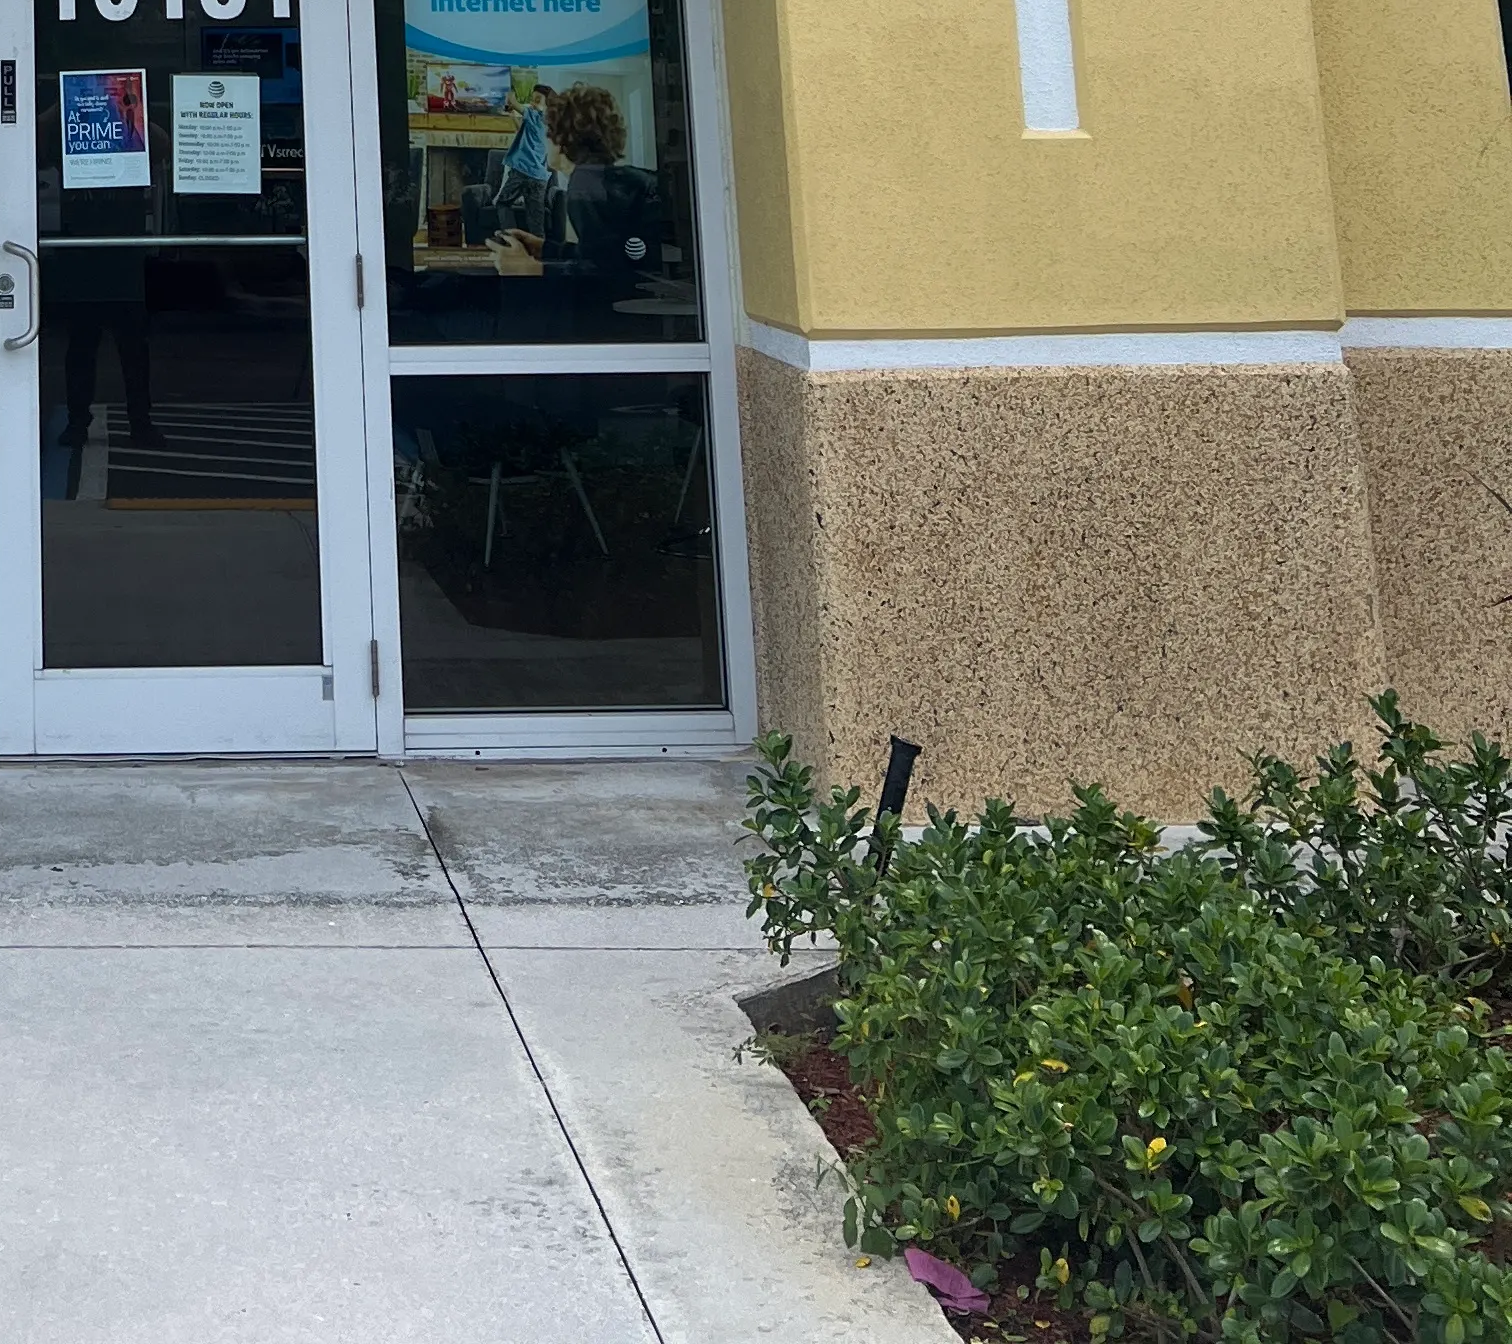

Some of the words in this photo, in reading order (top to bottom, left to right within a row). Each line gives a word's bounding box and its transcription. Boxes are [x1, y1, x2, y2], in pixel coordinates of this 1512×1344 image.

[3, 65, 13, 107] PULL
[216, 101, 234, 109] OPEN
[68, 110, 81, 123] At
[67, 121, 123, 141] PRIME
[68, 141, 89, 153] you
[90, 140, 111, 150] can
